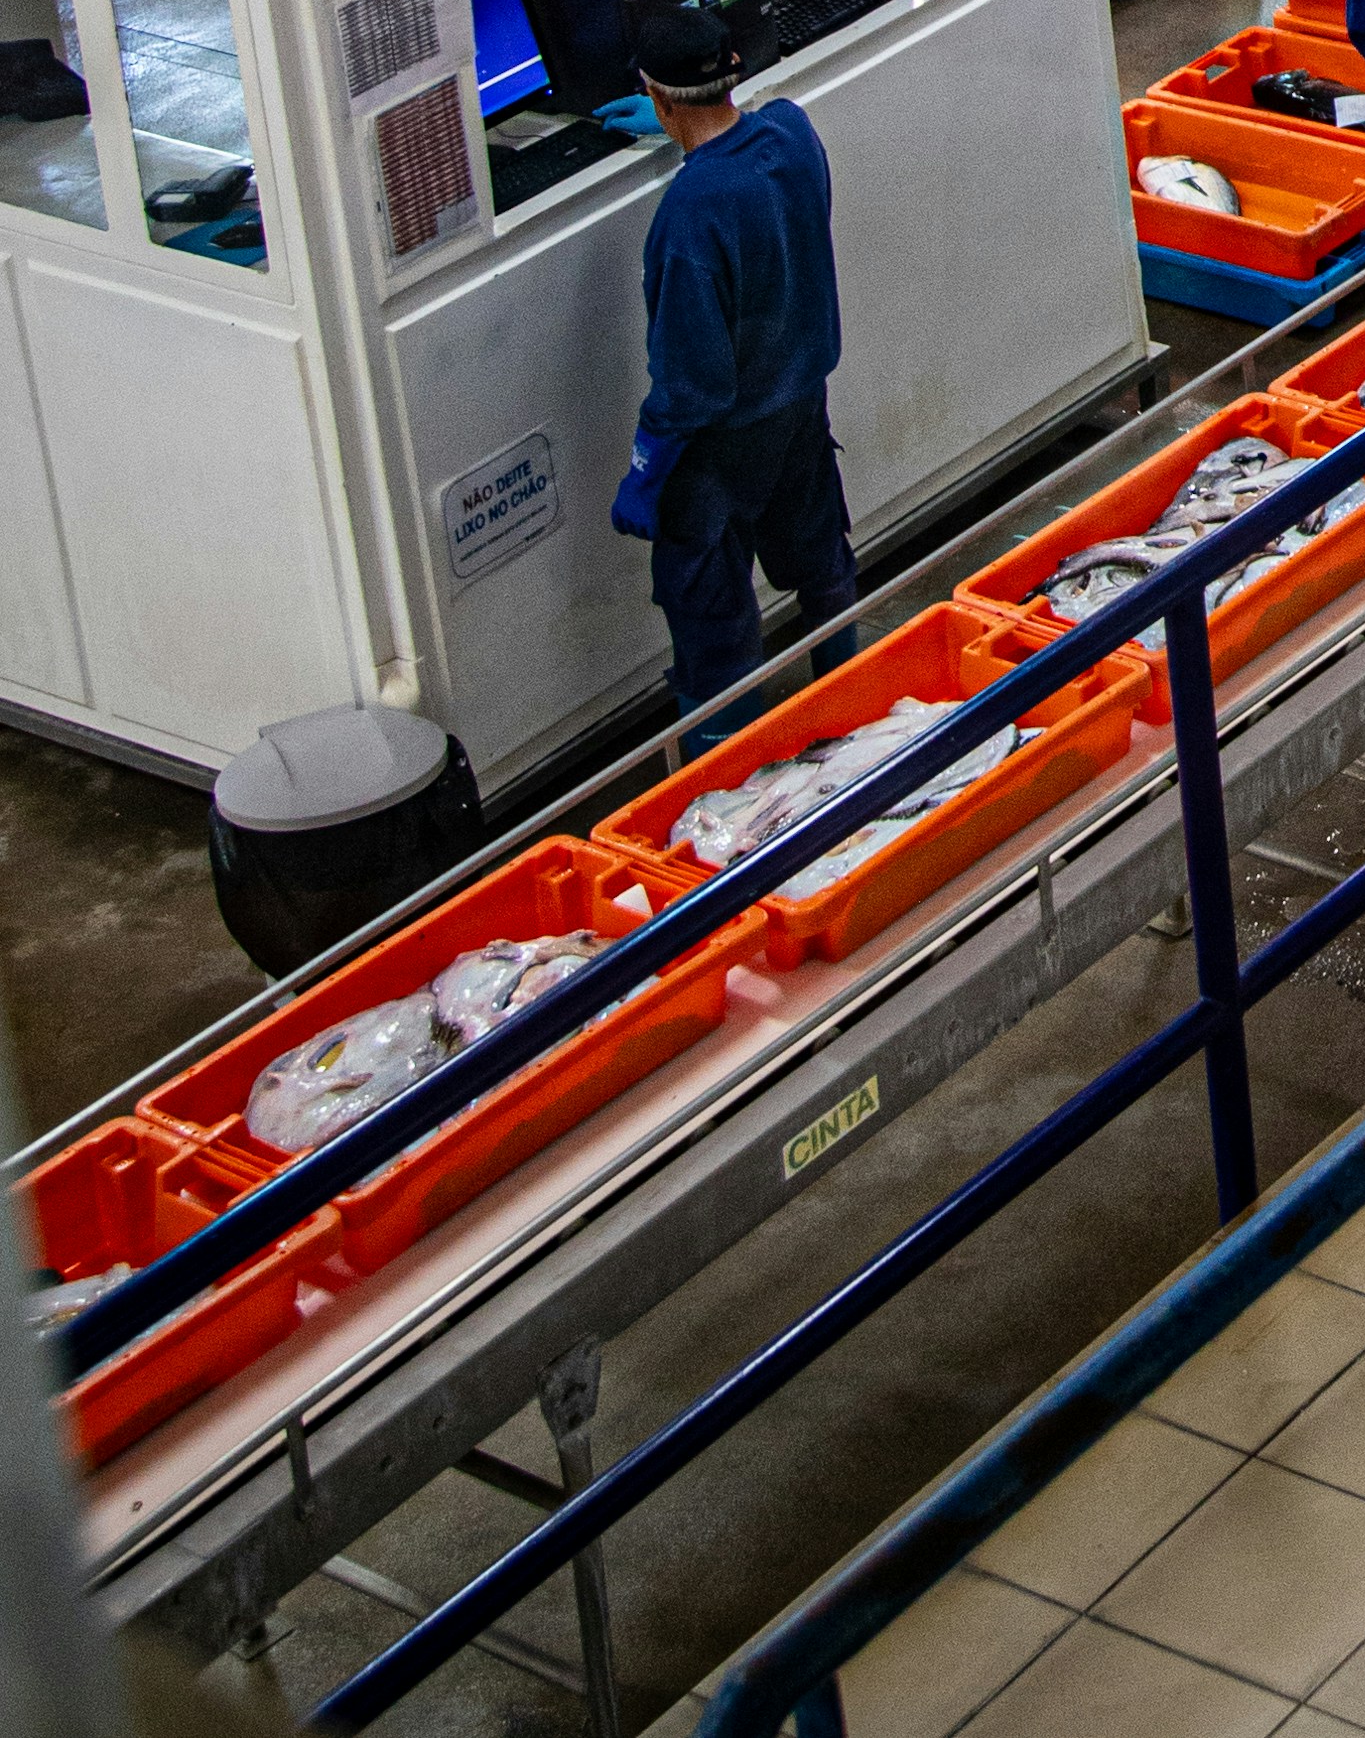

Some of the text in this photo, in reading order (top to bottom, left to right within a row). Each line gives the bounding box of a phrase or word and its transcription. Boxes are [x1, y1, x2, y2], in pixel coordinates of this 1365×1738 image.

[454, 513, 485, 544] LIXO
[488, 499, 508, 523] NO
[510, 475, 547, 508] CHÃO
[462, 459, 532, 513] NÃO DEITE
[788, 1088, 875, 1170] CINTA
